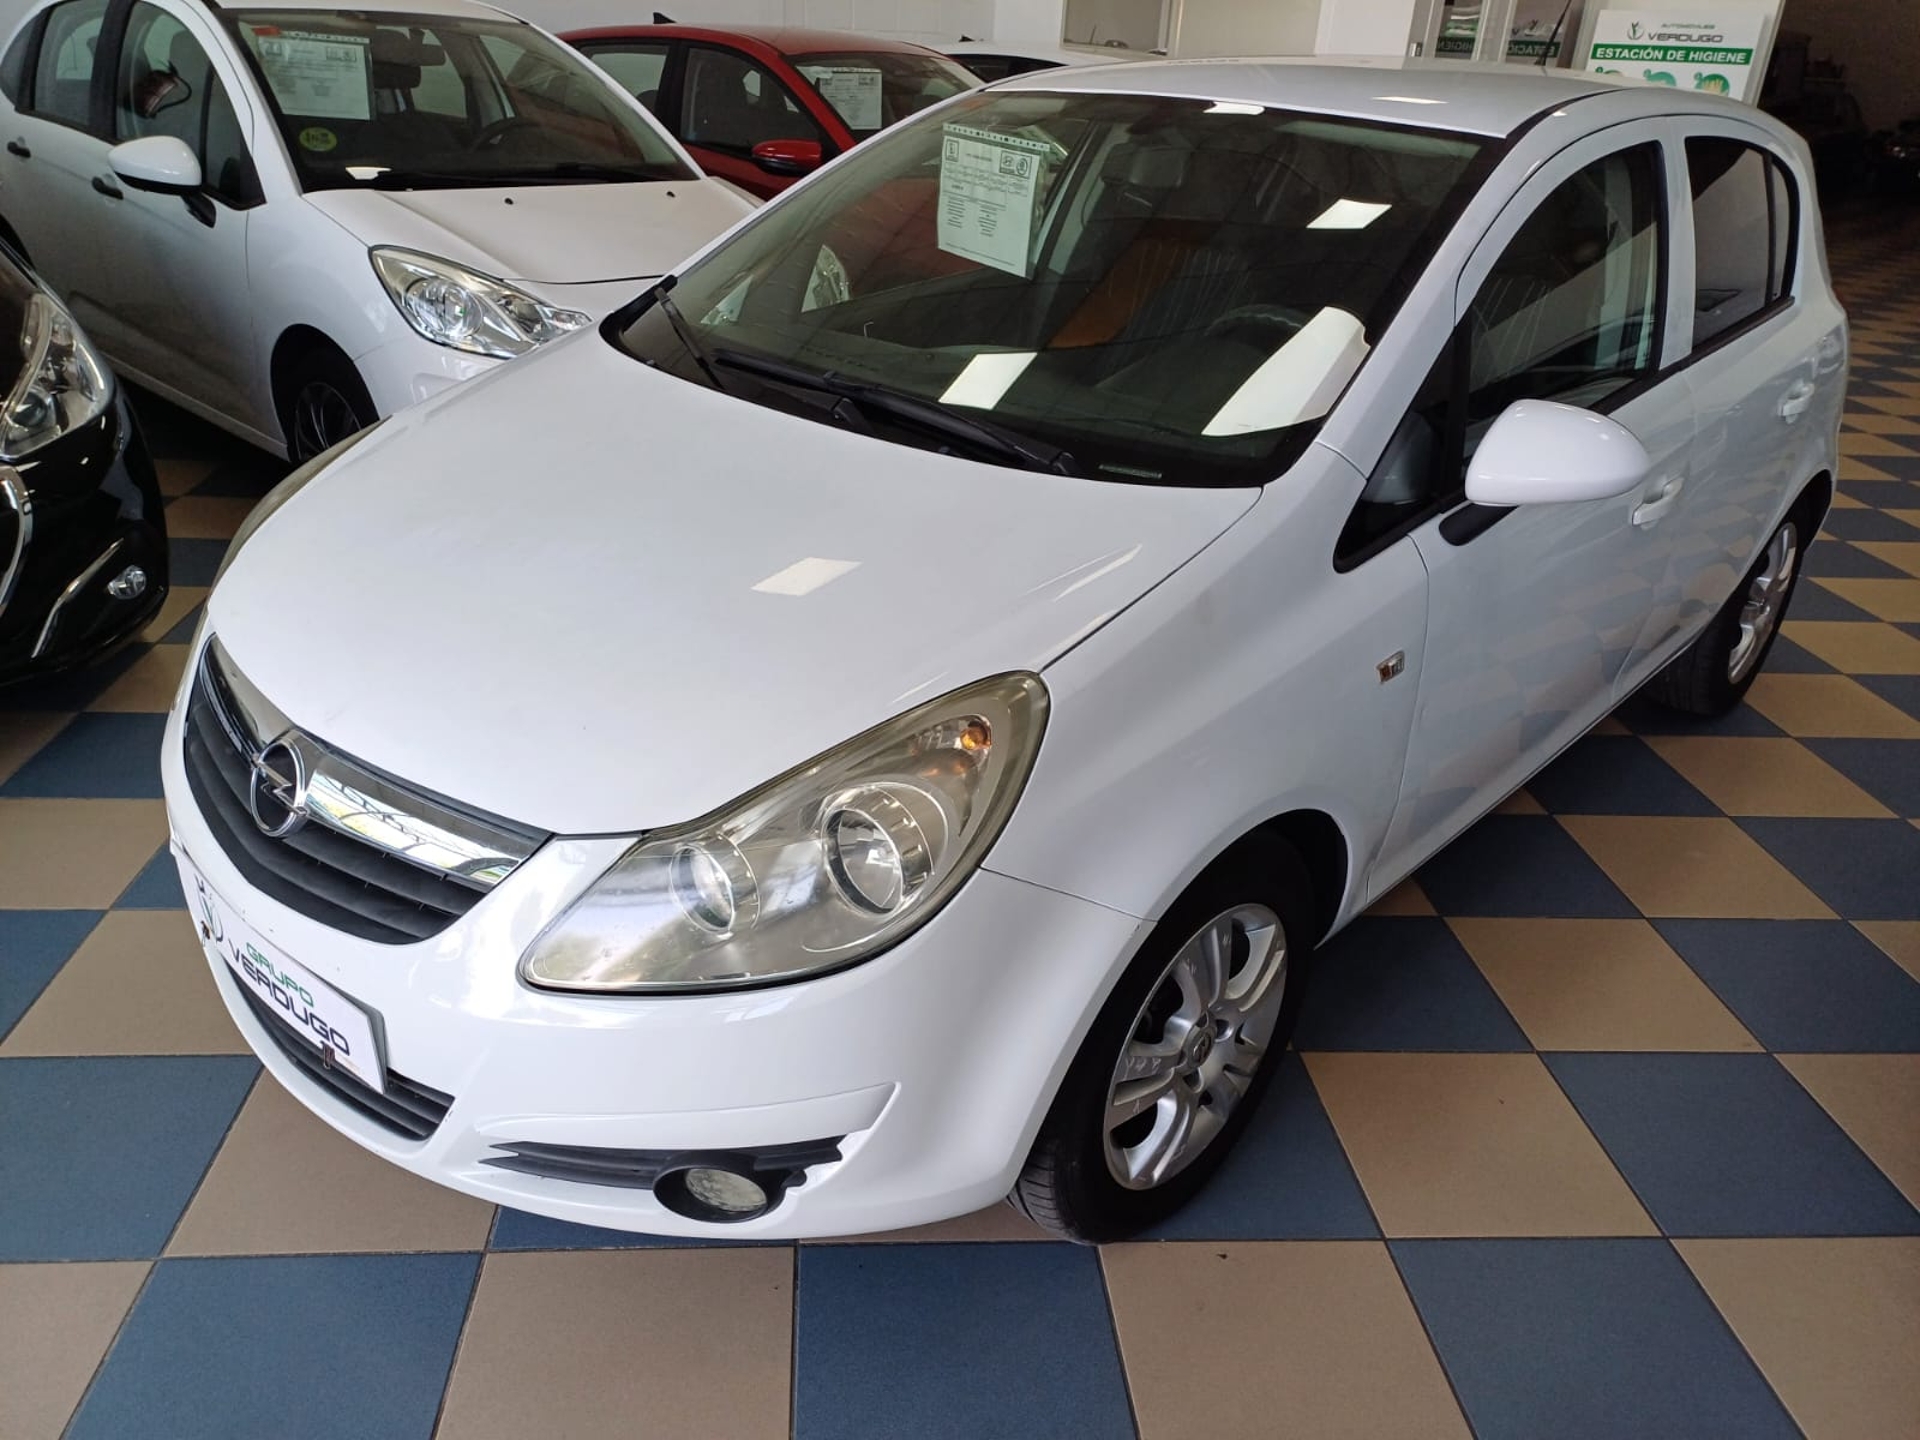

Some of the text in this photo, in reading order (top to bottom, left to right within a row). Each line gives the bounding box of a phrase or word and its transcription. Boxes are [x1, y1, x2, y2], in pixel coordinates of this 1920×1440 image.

[1595, 47, 1747, 63] ESTACIÓN DE HIGIENE
[1648, 32, 1724, 43] VERDUGO
[246, 942, 314, 1008] GRUPO
[228, 938, 350, 1056] VERDUGO
